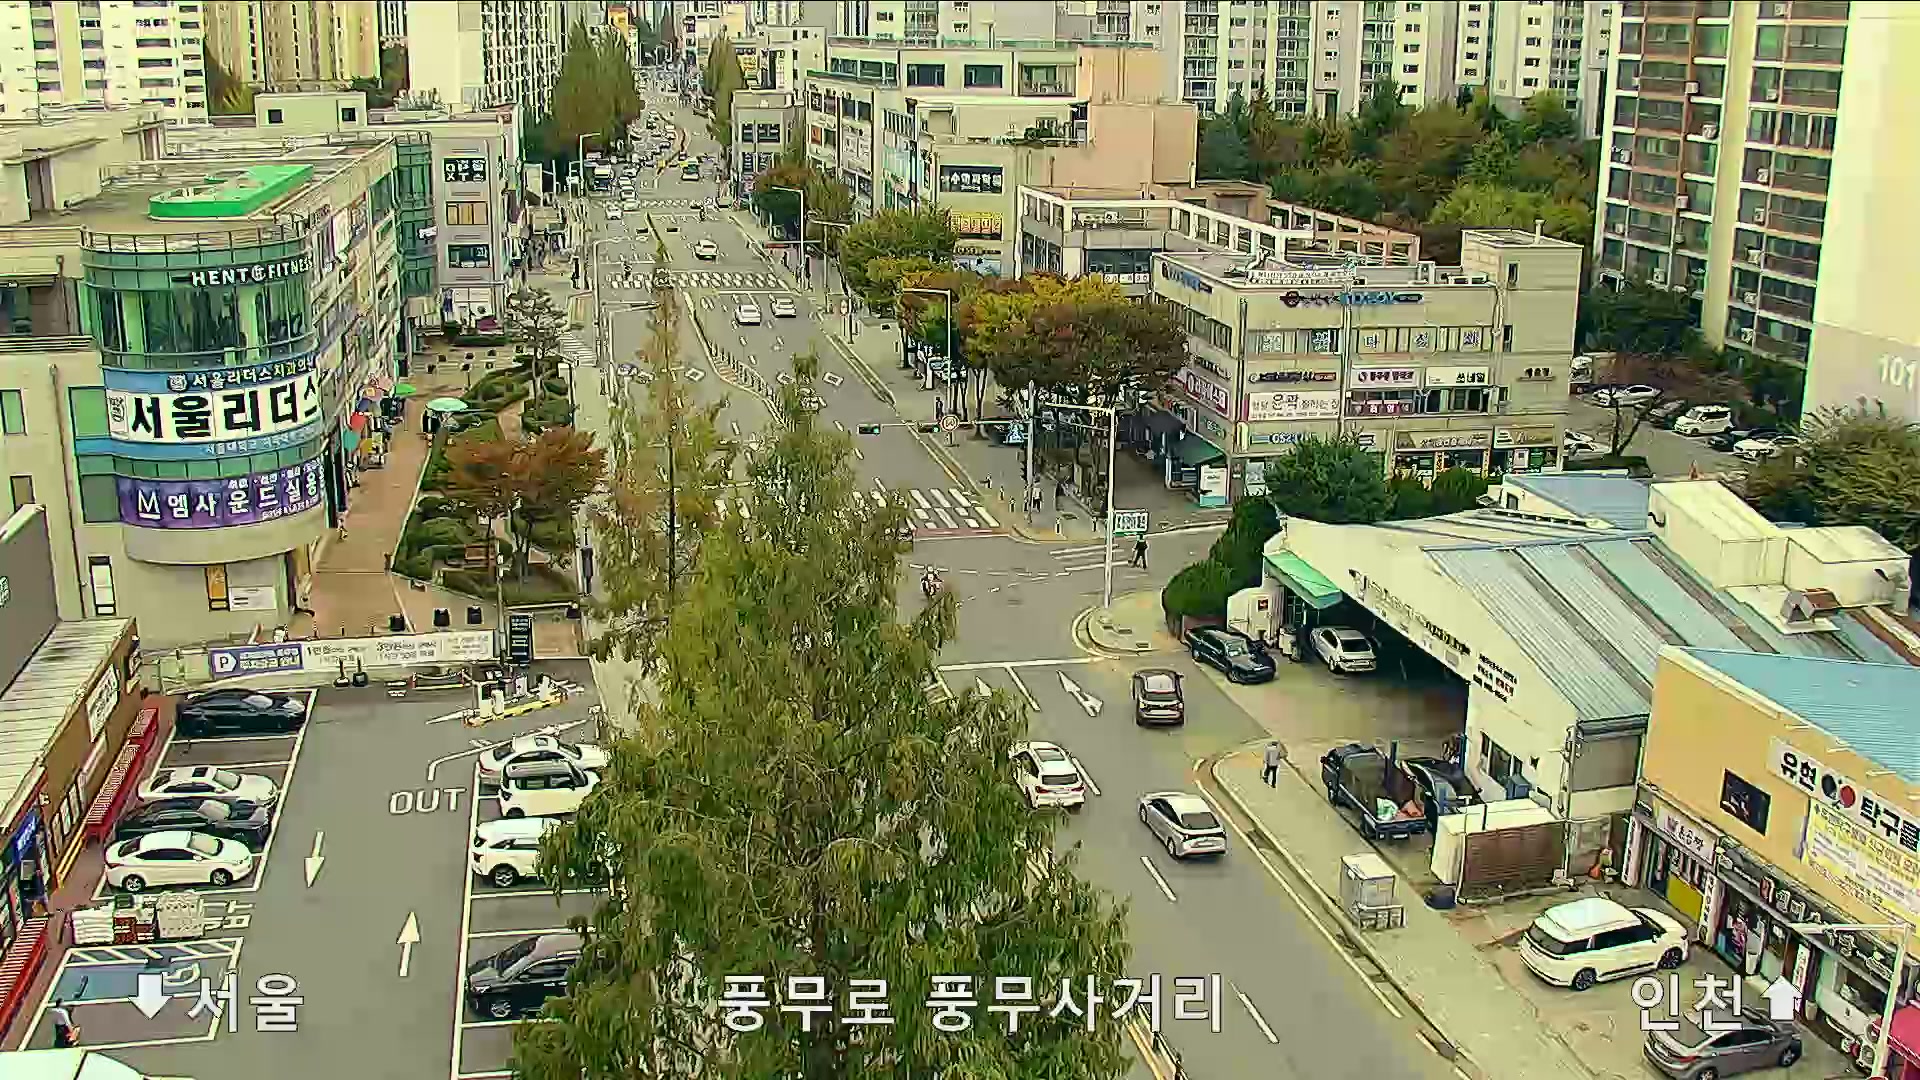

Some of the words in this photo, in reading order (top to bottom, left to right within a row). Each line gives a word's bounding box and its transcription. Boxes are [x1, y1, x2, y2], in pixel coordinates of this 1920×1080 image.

[191, 267, 248, 287] HENT
[130, 375, 318, 439] 서울리더스
[1780, 751, 1818, 793] 유현
[388, 787, 468, 815] OUT
